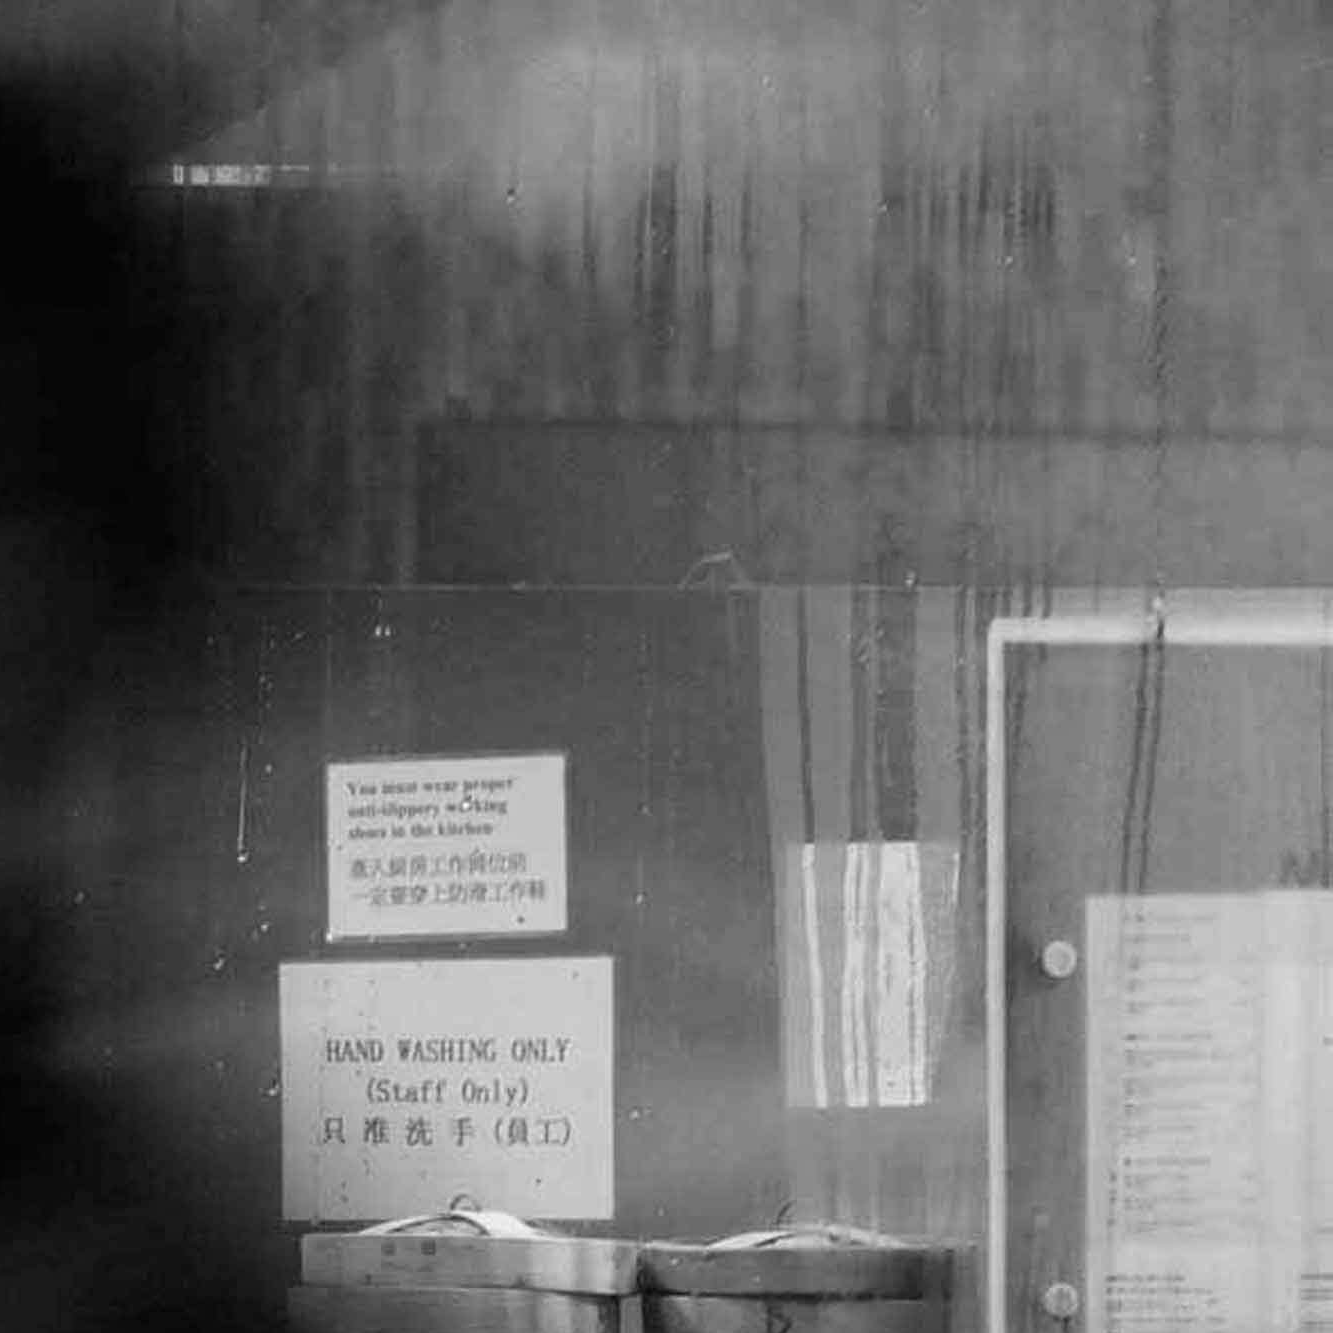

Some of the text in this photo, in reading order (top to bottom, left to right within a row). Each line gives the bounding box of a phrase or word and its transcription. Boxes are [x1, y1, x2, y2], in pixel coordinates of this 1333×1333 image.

[326, 1037, 571, 1064] HAND WASHING ONLY
[367, 1077, 529, 1107] (Staff Only)
